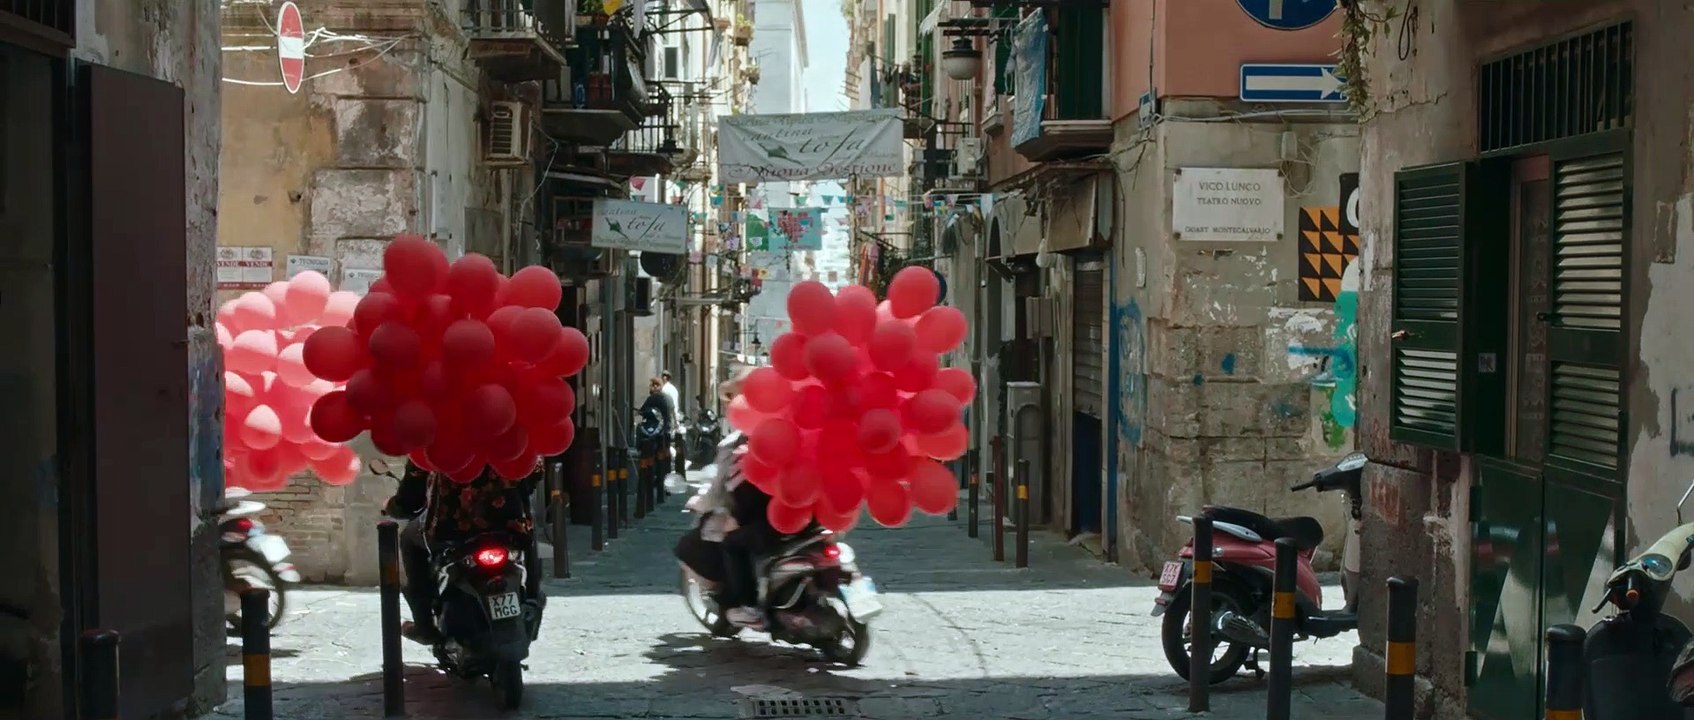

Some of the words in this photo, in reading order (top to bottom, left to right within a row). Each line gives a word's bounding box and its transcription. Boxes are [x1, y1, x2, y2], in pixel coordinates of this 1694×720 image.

[799, 128, 865, 165] tofa
[1199, 181, 1224, 191] VICO
[1196, 197, 1228, 205] TEATRO
[1230, 197, 1262, 206] NUOVO
[492, 594, 514, 607] X77
[494, 605, 518, 618] MGG
